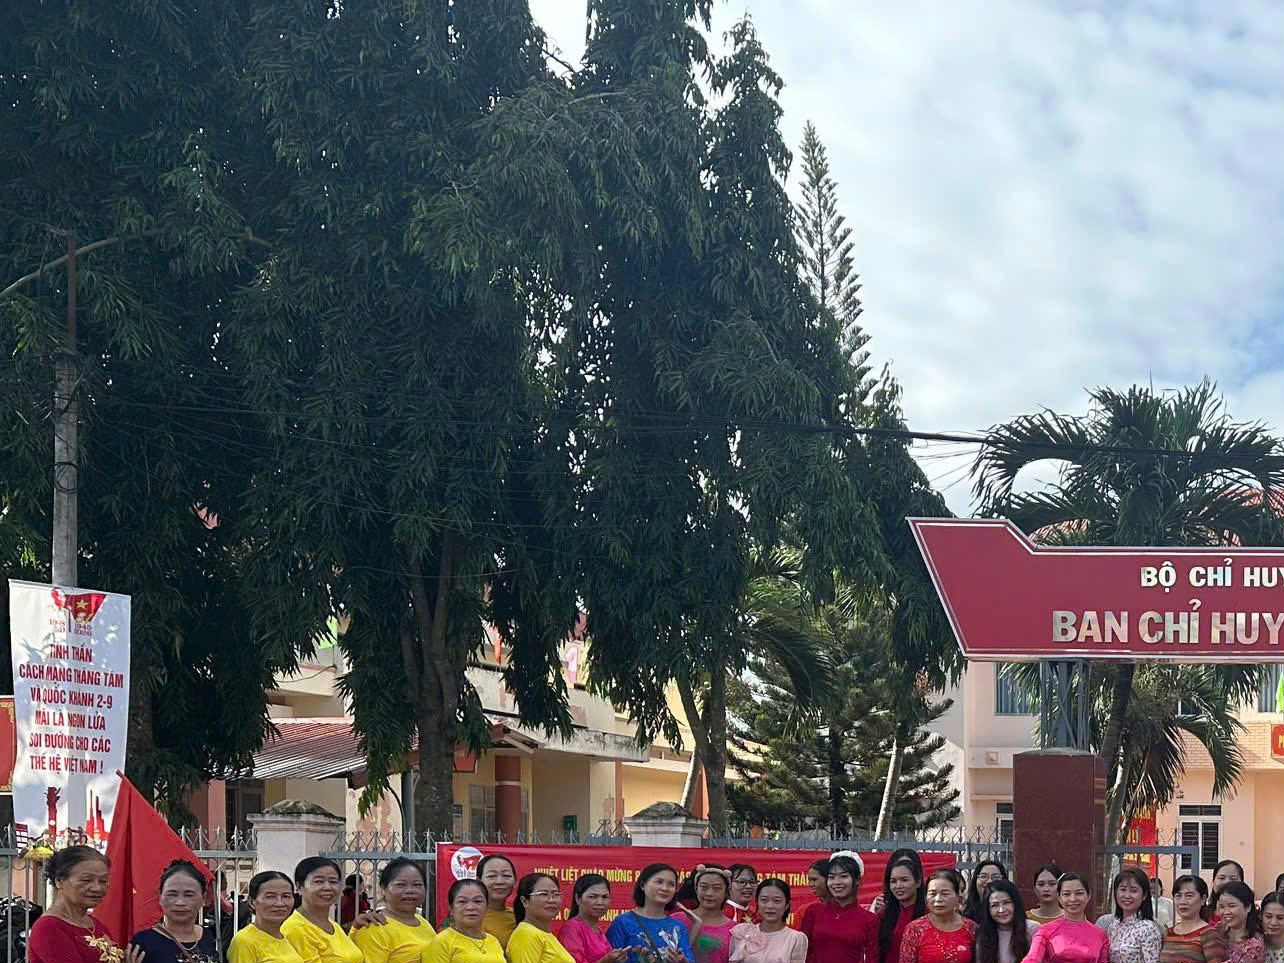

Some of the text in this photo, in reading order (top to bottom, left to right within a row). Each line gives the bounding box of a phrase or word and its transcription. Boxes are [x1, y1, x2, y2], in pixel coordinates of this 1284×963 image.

[1140, 561, 1177, 592] BỘ
[1188, 557, 1233, 587] CHỈ
[1052, 610, 1128, 643] BAN
[1138, 598, 1201, 644] CHỈ
[49, 643, 69, 660] TINH
[19, 661, 44, 680] CÁCH
[74, 667, 101, 686] THÁNG
[103, 670, 124, 688] TÁM
[30, 684, 41, 702] VÀ
[69, 688, 94, 707] KHÁNH
[96, 694, 113, 709] 2-9
[53, 709, 64, 726] LÀ
[29, 733, 42, 747] SOI
[75, 736, 89, 751] CHO
[91, 735, 111, 753] CÁC
[79, 758, 97, 774] NAM
